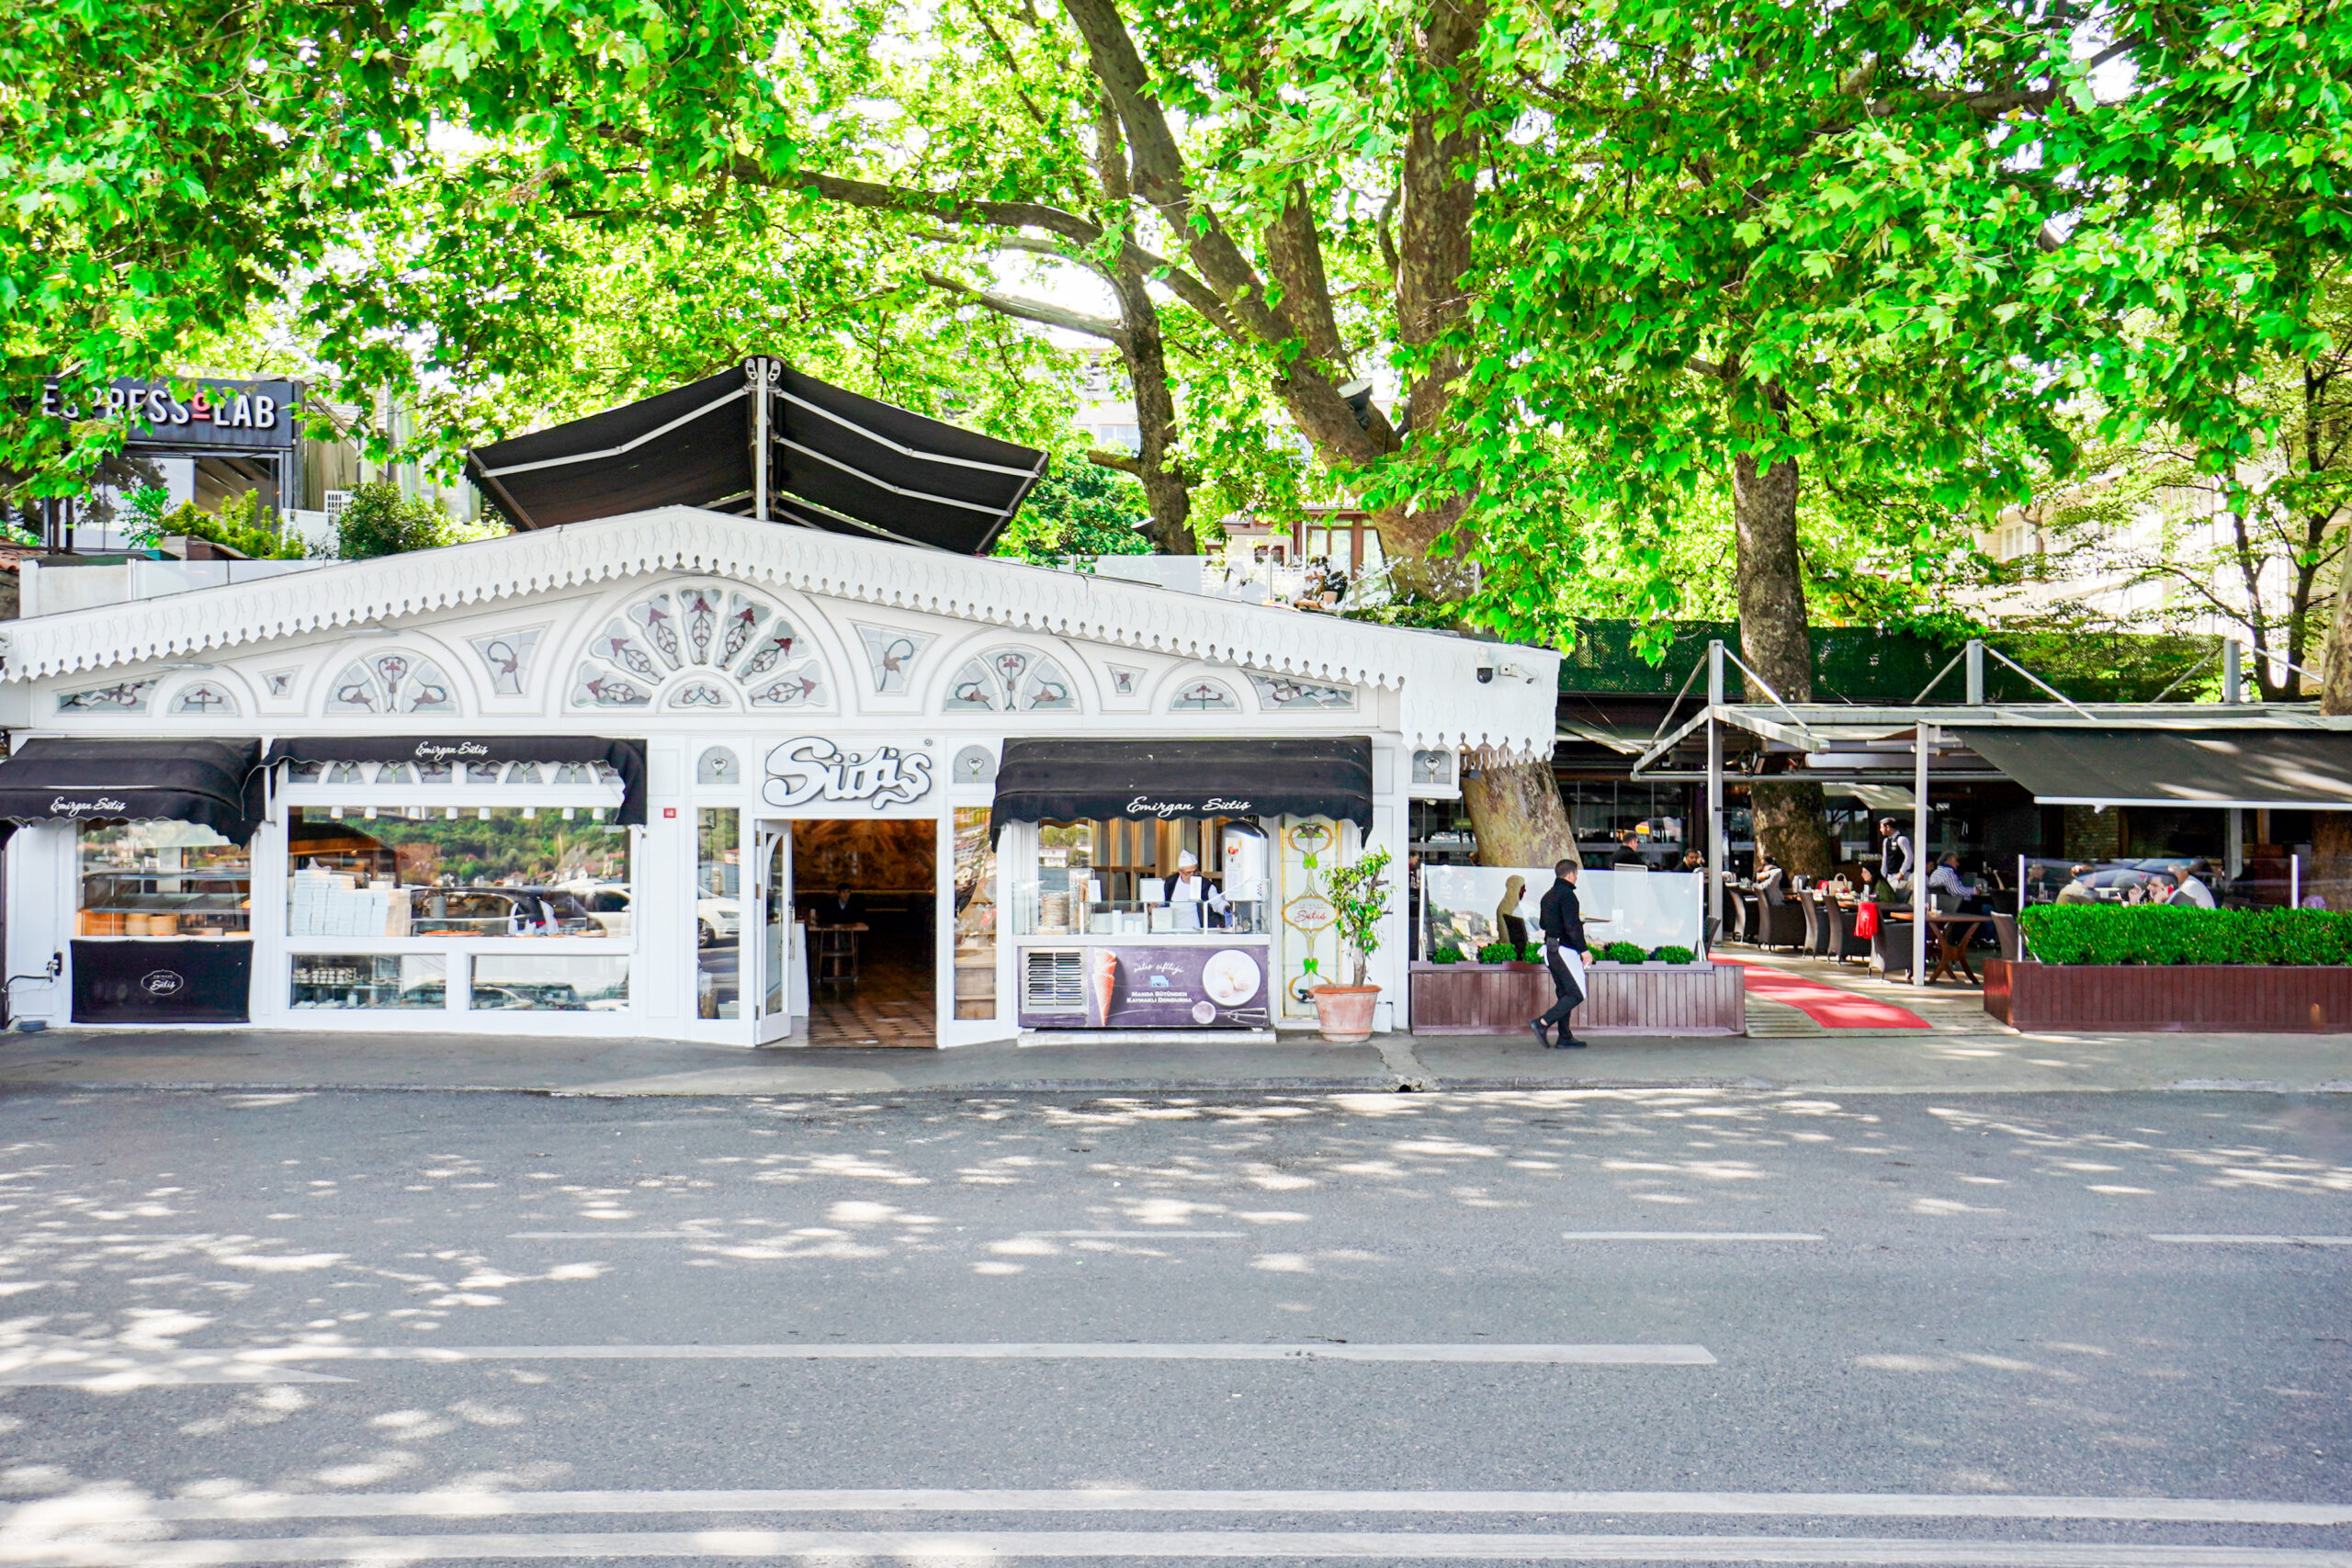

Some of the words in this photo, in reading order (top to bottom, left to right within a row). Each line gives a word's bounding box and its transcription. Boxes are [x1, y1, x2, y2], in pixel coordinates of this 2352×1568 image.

[415, 740, 457, 761] Emirgan
[51, 795, 92, 817] Emirgan
[1126, 795, 1194, 818] Emirgan
[1202, 797, 1251, 811] Sütiş
